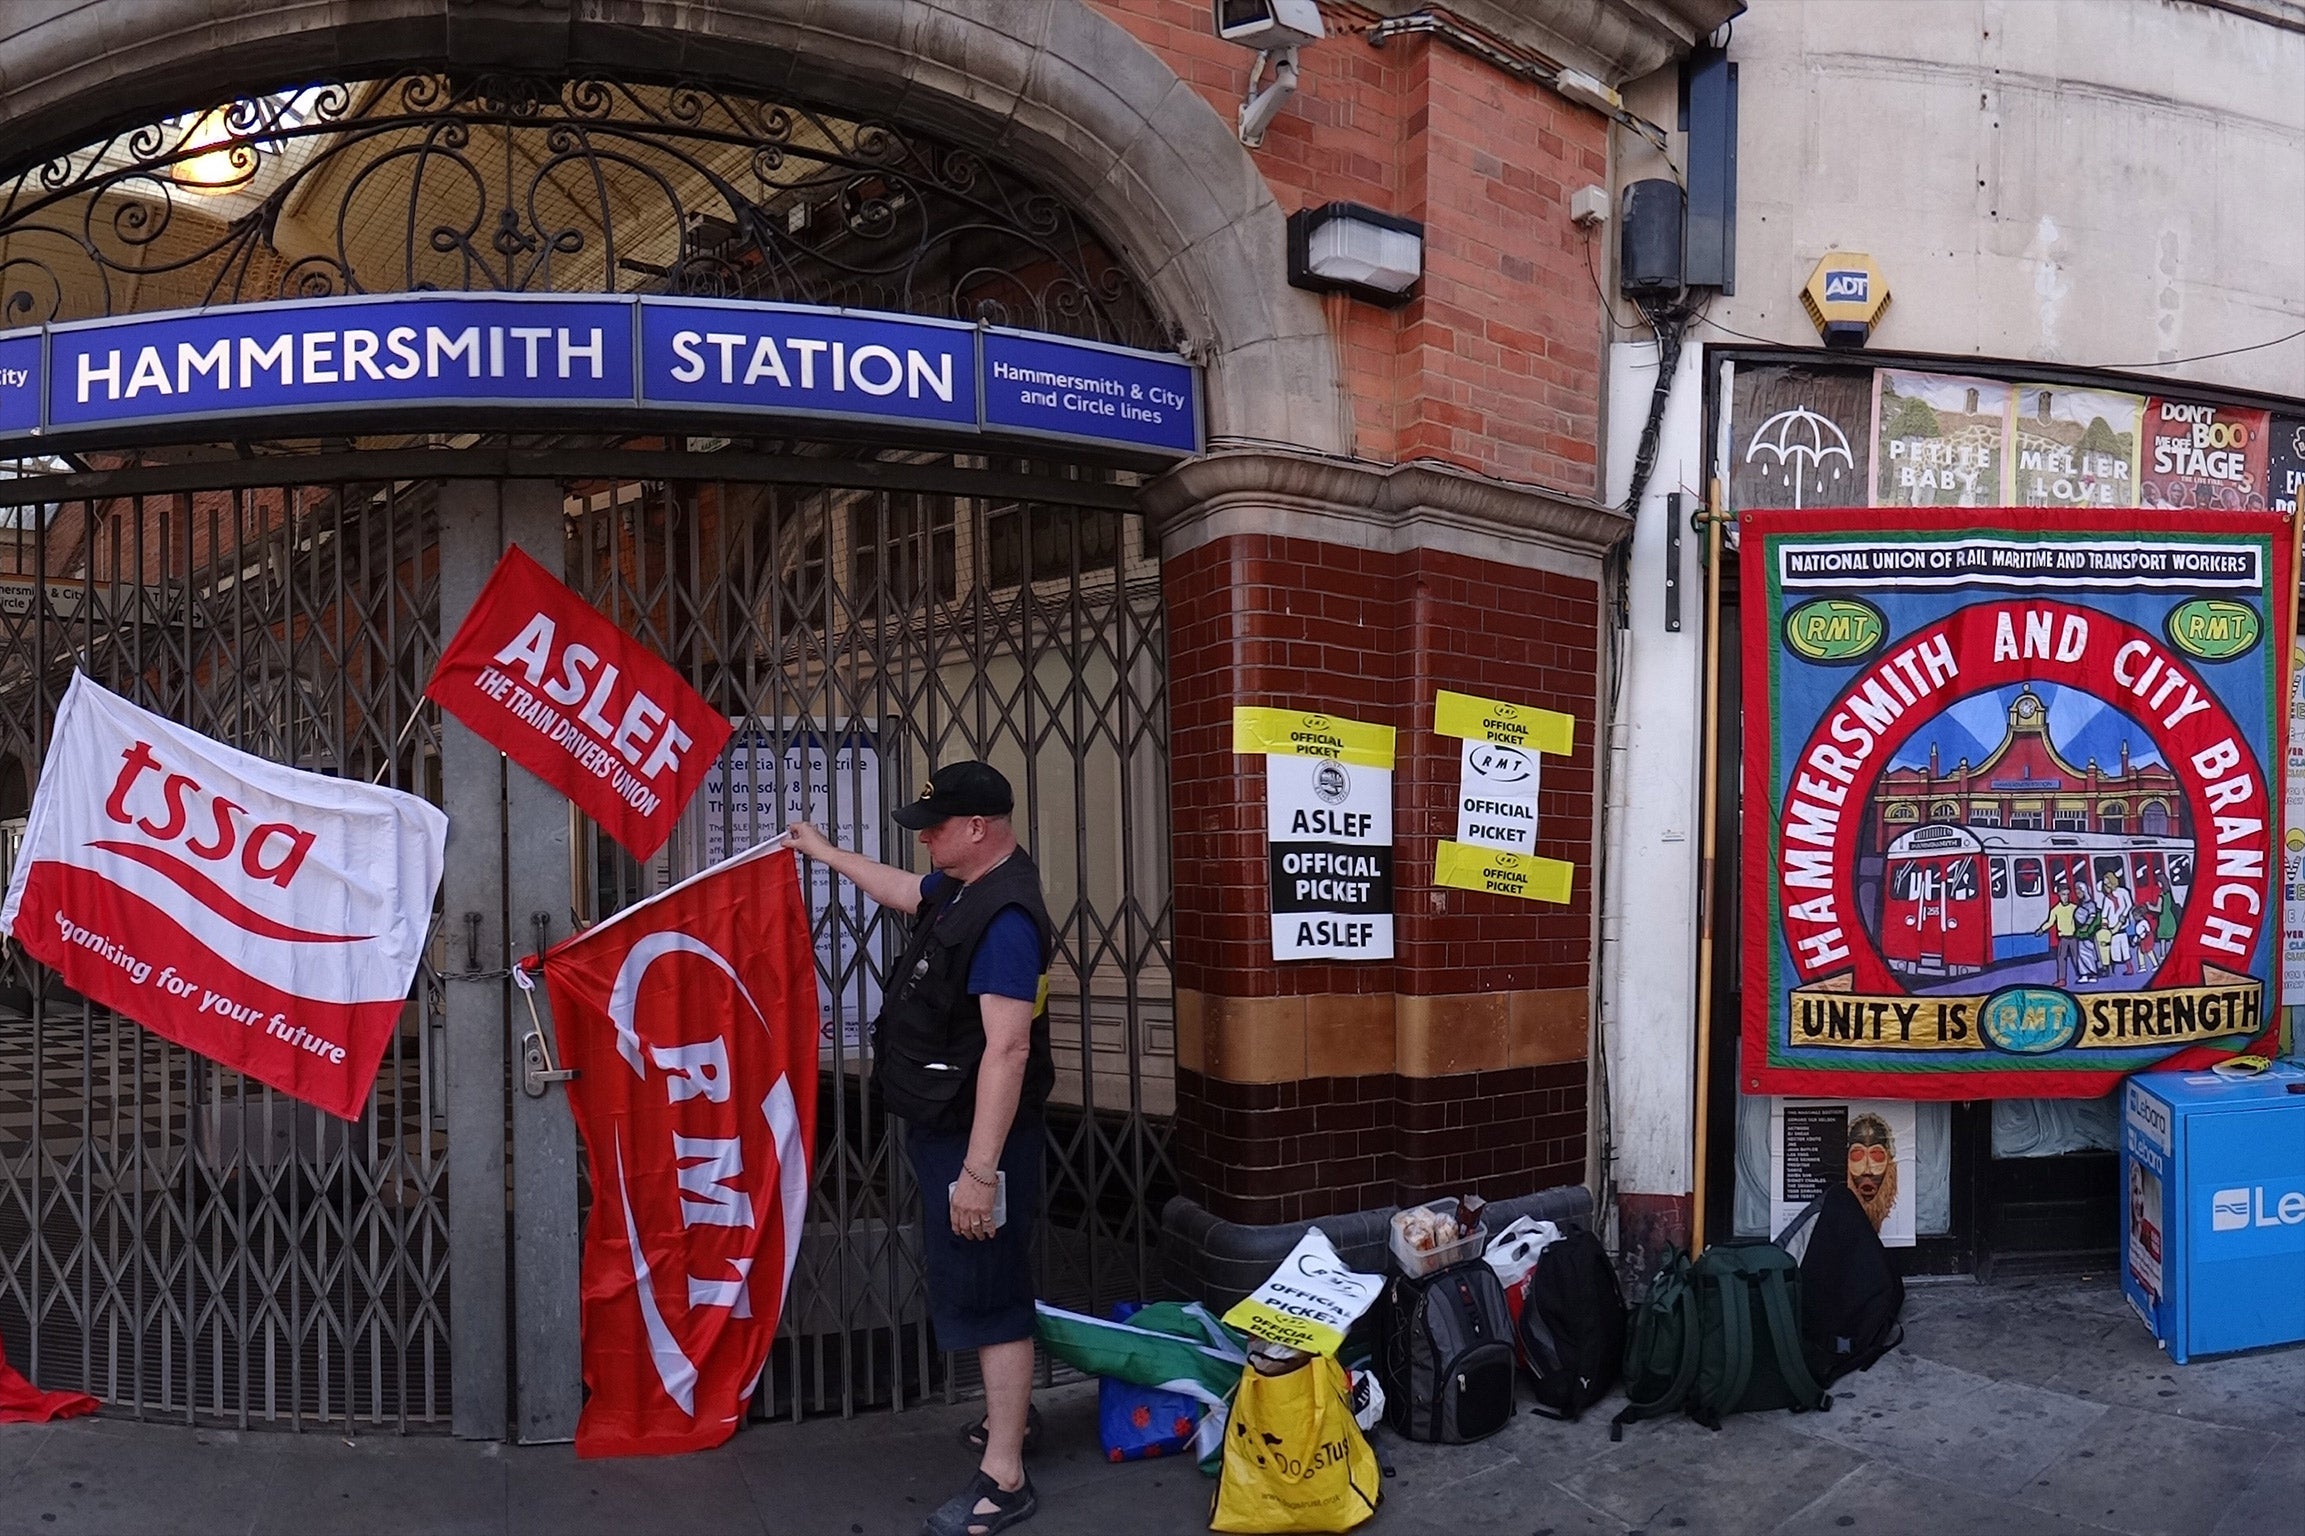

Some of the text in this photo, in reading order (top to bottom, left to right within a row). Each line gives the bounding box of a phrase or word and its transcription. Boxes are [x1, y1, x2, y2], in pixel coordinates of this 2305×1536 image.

[1826, 276, 1867, 296] ADT
[77, 326, 603, 403] HAMMERSMITH
[670, 330, 953, 402] STATION
[993, 361, 1185, 411] Hammersmith & City
[1021, 388, 1163, 424] and Circle lines
[2161, 402, 2216, 425] DON'T
[2192, 422, 2249, 449] BOO
[2019, 450, 2128, 480] MELLER
[2154, 445, 2245, 481] STAGE
[2034, 477, 2113, 503] LOVE
[1791, 549, 2247, 573] NATIONAL UNION OF RAIL MARITIME AND TRANSPORT WORKERS
[1806, 616, 1869, 642] RMT
[2187, 615, 2246, 641] RMT
[493, 612, 694, 781] ASLEF
[1291, 731, 1344, 748] OFFICIAL
[1482, 718, 1529, 735] OFFICIAL
[1487, 730, 1525, 746] PICKET
[473, 665, 510, 702] THE
[504, 684, 558, 735] TRAIN
[610, 764, 661, 818] UNION
[1296, 744, 1340, 759] PICKET
[1482, 755, 1522, 772] RMT
[1784, 610, 2265, 971] HAMMERSMITH AND CITY BRANCH
[104, 740, 317, 889] tssa
[1463, 798, 1534, 820] OFFICIAL
[1291, 809, 1372, 838] ASLEF
[1468, 824, 1527, 843] PICKET
[1282, 853, 1381, 877] OFFICIAL
[1482, 867, 1529, 884] OFFICIAL
[1296, 879, 1371, 903] PICKET
[1486, 880, 1524, 895] PICKET
[1296, 920, 1373, 947] ASLEF
[157, 965, 199, 999] for
[199, 989, 265, 1027] your
[266, 1012, 347, 1066] future
[1799, 998, 1969, 1041] UNITY IS
[2000, 1002, 2067, 1031] RMT
[2091, 996, 2260, 1037] STRENGTH
[2135, 1092, 2166, 1134] Lebara
[2133, 1132, 2163, 1176] Lebara
[1264, 1297, 1339, 1325] PICKET
[1270, 1283, 1353, 1318] OFFICIAL
[1249, 1324, 1304, 1346] PICKET
[1251, 1316, 1315, 1341] OFFICIAL
